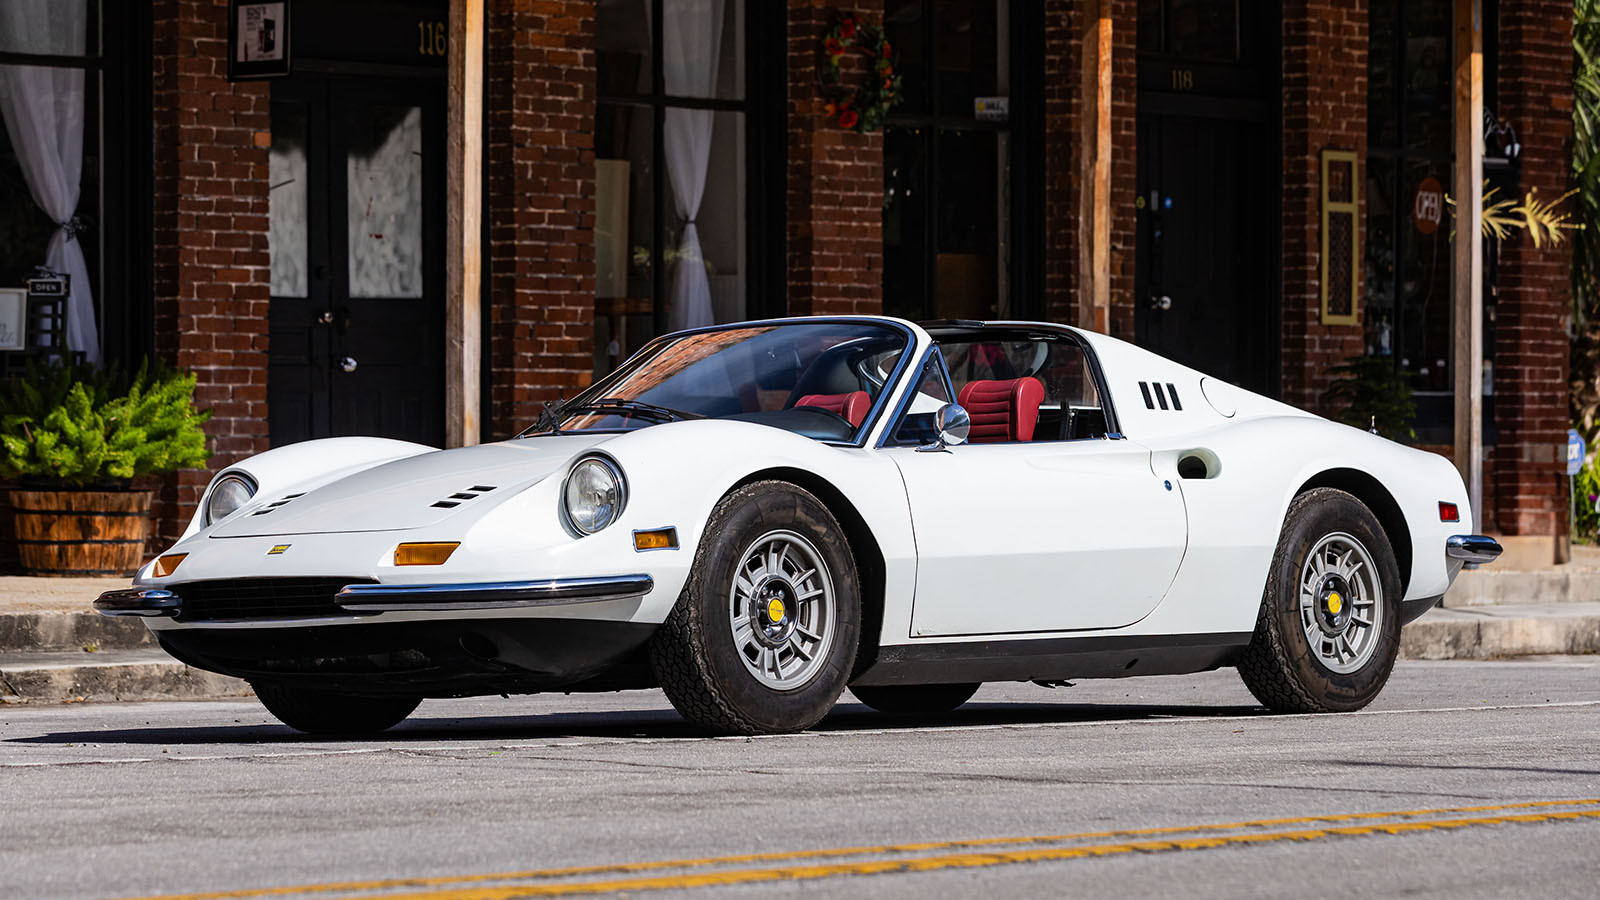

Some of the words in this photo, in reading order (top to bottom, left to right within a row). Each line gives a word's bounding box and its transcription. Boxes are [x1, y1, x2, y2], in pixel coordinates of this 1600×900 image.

[418, 20, 447, 56] 116
[1171, 69, 1193, 90] 118
[1416, 190, 1442, 224] OPEN
[35, 283, 57, 292] OPEN
